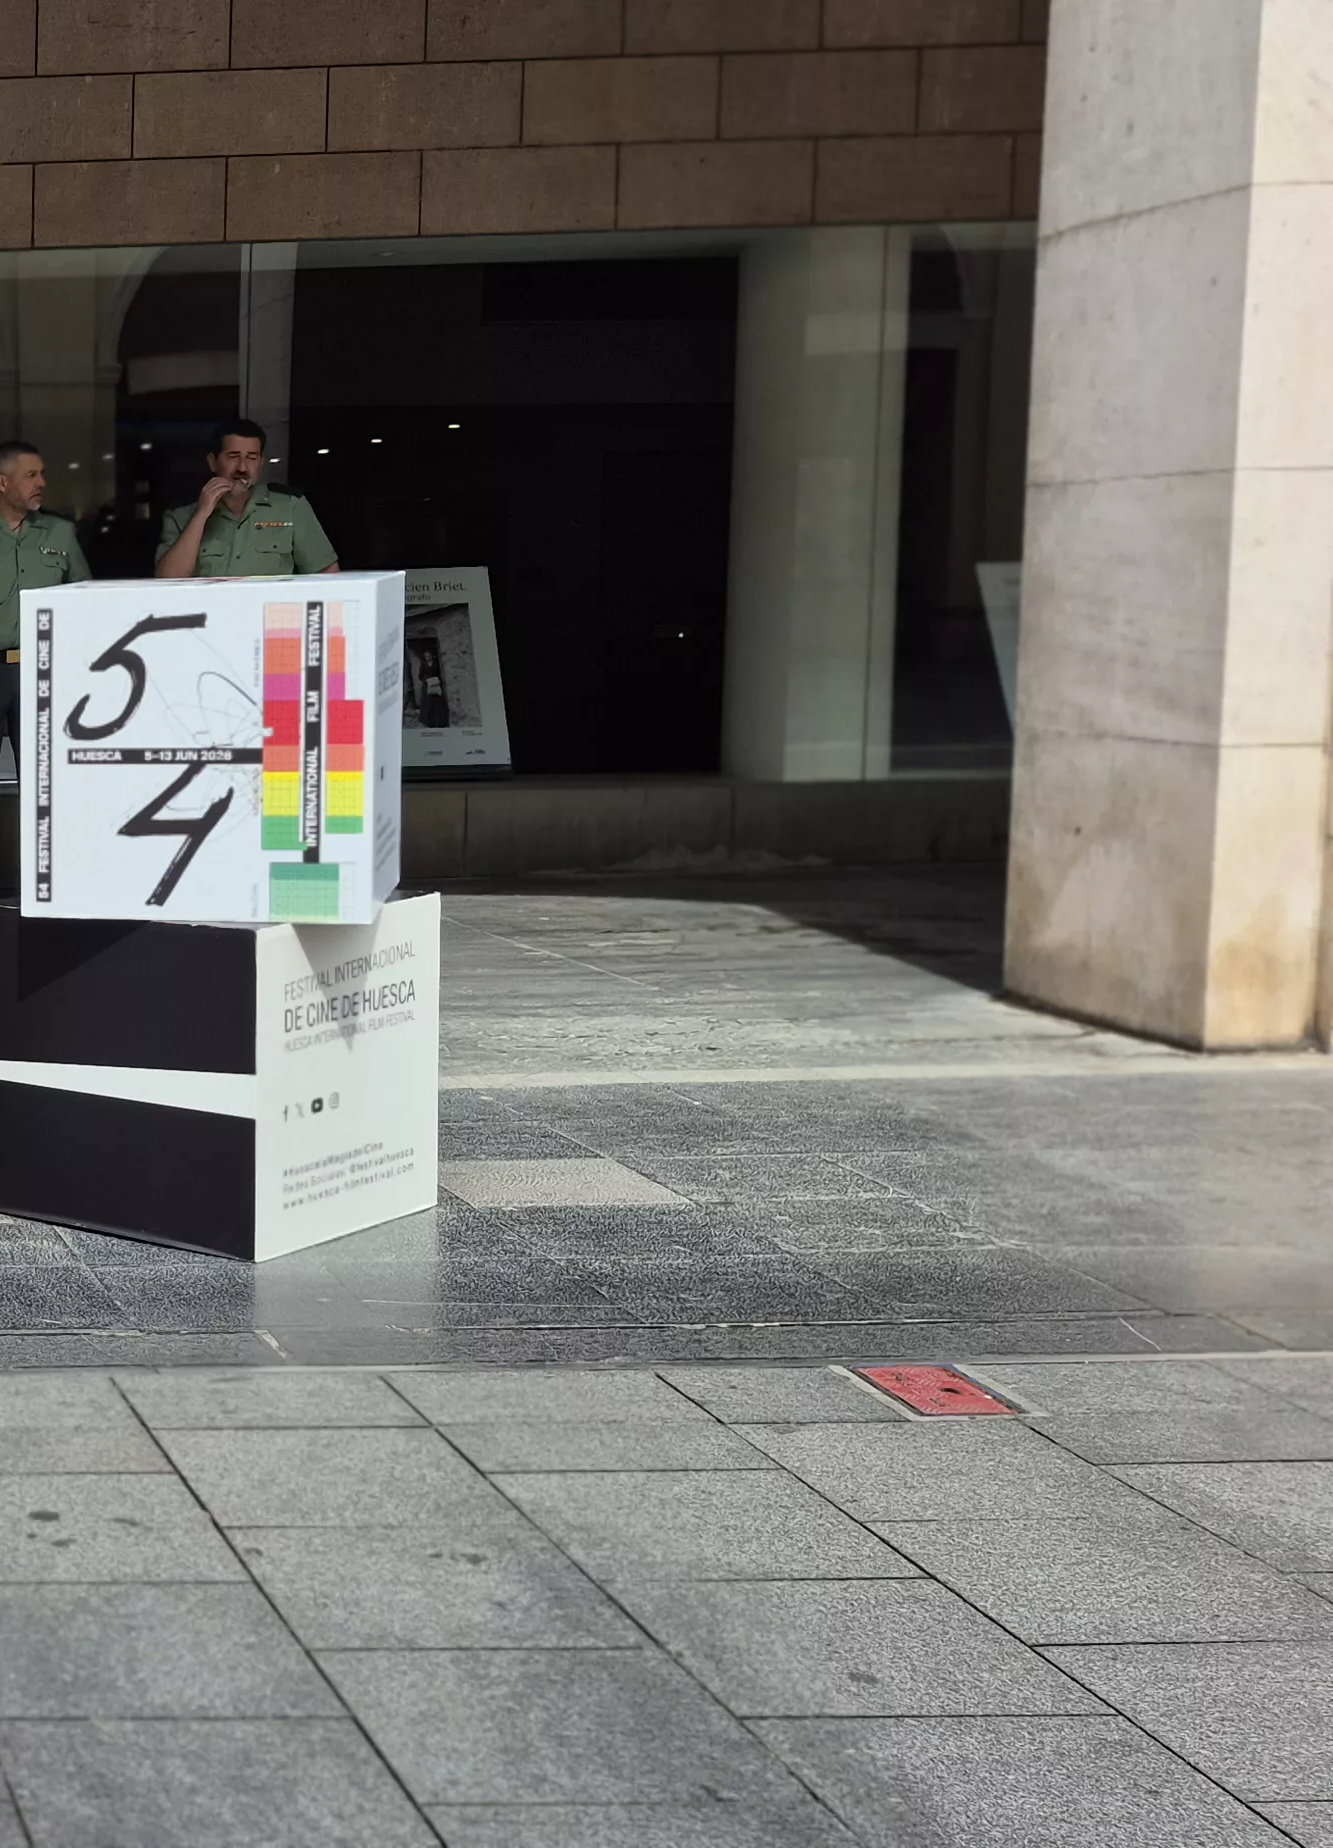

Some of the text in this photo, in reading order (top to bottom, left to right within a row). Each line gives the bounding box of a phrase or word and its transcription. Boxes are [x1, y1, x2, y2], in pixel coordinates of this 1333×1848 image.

[38, 612, 50, 631] DE
[39, 639, 50, 670] CINE
[63, 612, 207, 741] 5
[39, 678, 50, 697] DE
[305, 604, 322, 847] INTERNATIONAL FILM FESTIVAL
[38, 706, 50, 806] INTERNACIONAL
[71, 751, 123, 762] HUESCA
[174, 751, 198, 762] JUN
[38, 815, 50, 873] FESTIVAL
[117, 762, 235, 907] 4
[284, 940, 415, 1002] FESTIVAL INTERNACIONAL
[284, 979, 416, 1034] DE CINE DE HUESCA
